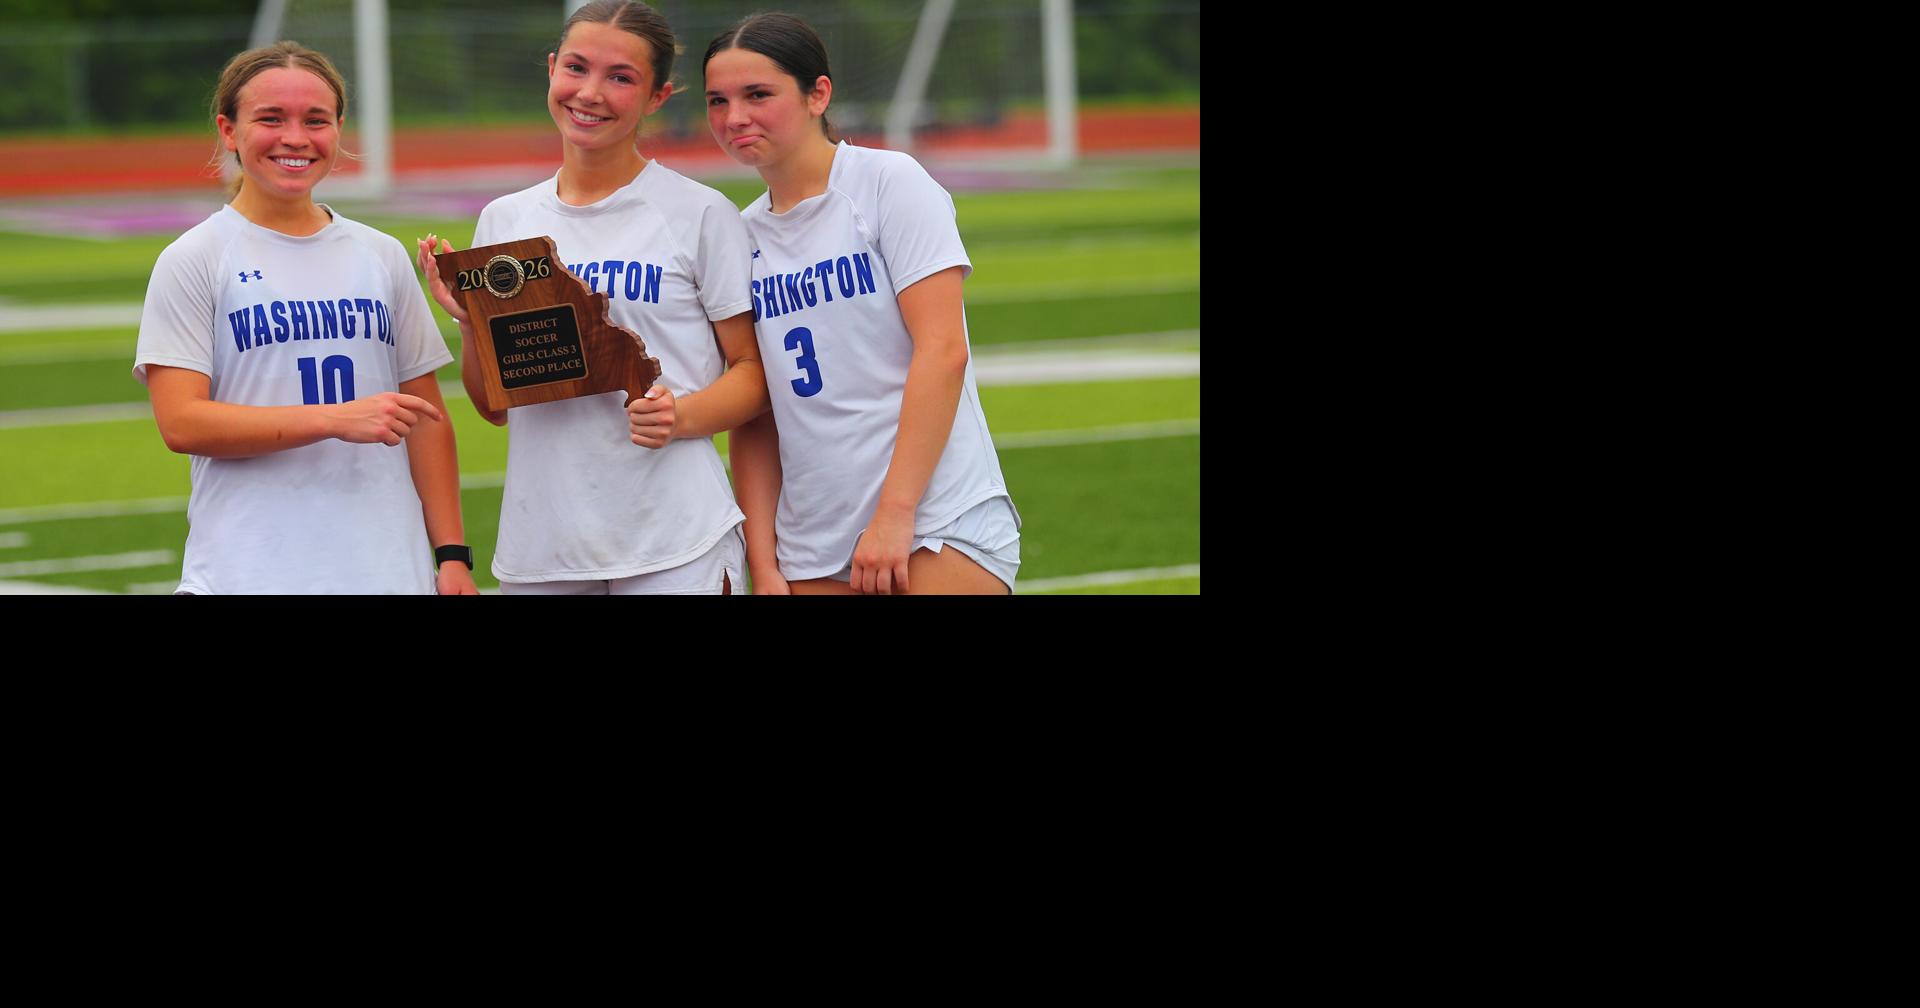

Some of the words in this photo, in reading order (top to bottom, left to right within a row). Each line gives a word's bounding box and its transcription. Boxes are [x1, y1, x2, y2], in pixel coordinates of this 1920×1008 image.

[458, 269, 483, 290] 20
[524, 257, 550, 280] 26
[509, 318, 557, 334] DISTRICT
[515, 333, 558, 347] SOCCER
[503, 351, 535, 365] GIRLS
[536, 346, 569, 359] CLASS
[571, 345, 577, 354] 3
[784, 327, 822, 397] 3
[503, 365, 545, 380] SECOND
[548, 358, 582, 372] PLACE
